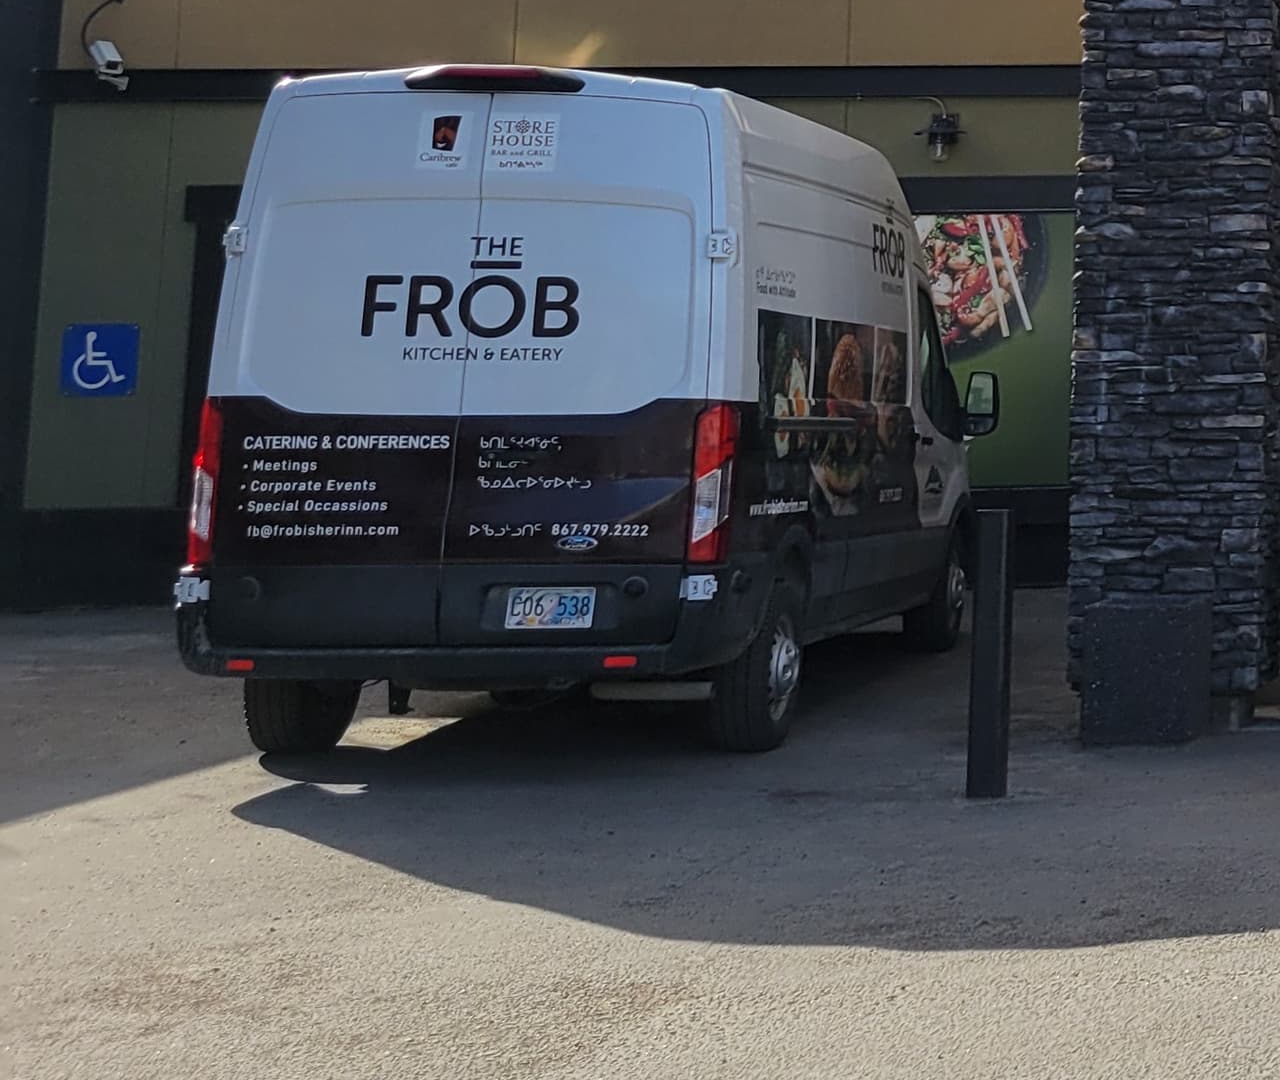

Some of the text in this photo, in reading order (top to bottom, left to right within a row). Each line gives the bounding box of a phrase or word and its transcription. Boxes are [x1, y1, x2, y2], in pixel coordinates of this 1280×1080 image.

[493, 118, 555, 134] STORE
[492, 135, 554, 147] HOUSE
[527, 149, 552, 157] GRILL
[470, 236, 525, 257] THE
[872, 223, 905, 279] FROB
[361, 274, 580, 339] FROB
[402, 347, 564, 361] KITCHEN & EATERY
[243, 435, 450, 450] CATERING & CONFERENCES
[252, 459, 318, 473] Meetings
[250, 479, 377, 494] Corporate Events
[247, 499, 388, 514] Special Occassions
[247, 523, 399, 538] fb@frobisherinn.com
[551, 523, 649, 537] 867.979.2222
[556, 595, 591, 617] 538
